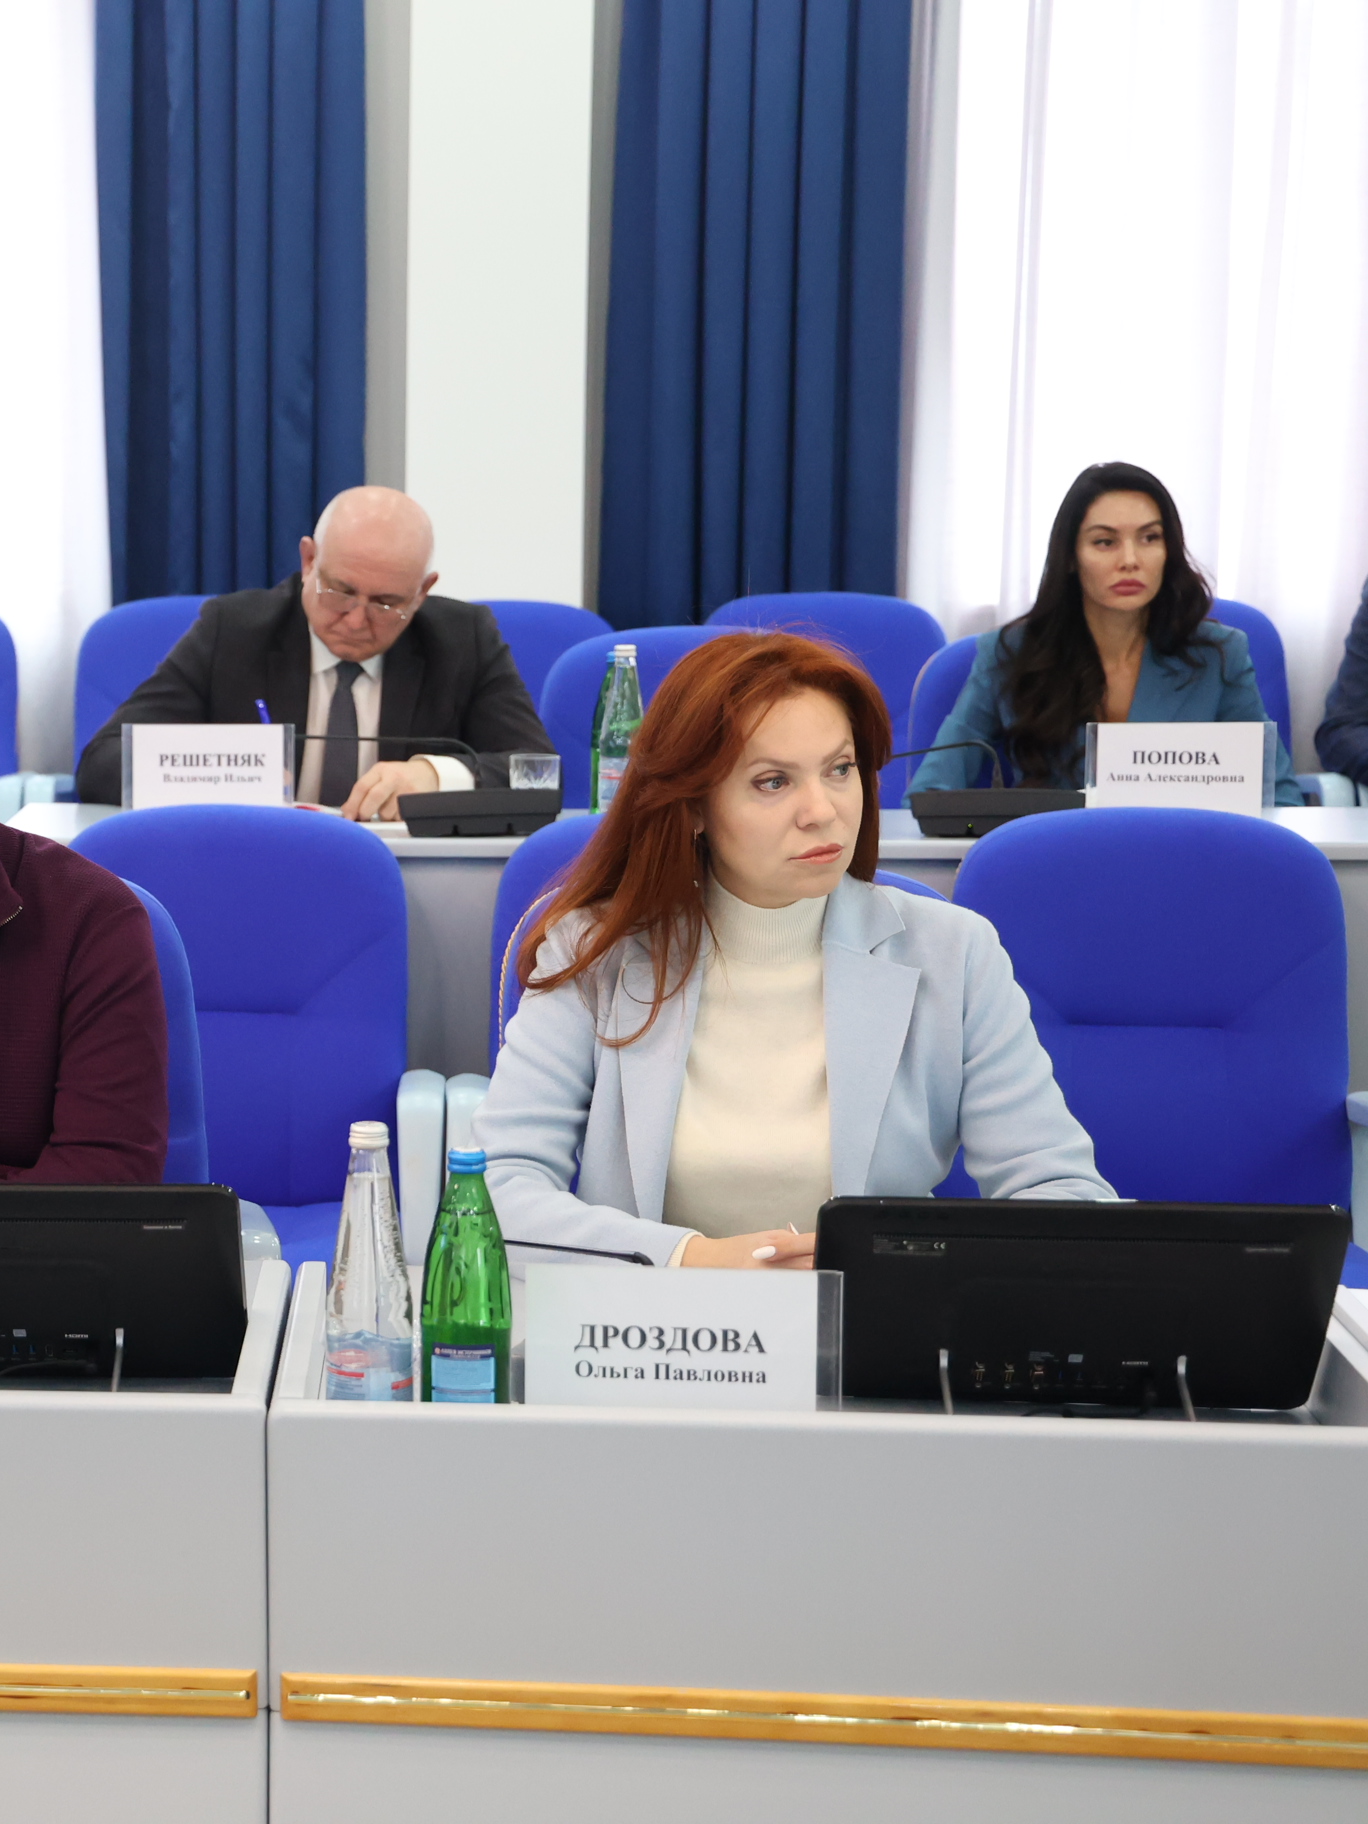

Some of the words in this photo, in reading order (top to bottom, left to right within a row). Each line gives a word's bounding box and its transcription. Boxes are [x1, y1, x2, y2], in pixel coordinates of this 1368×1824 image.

[159, 753, 266, 768] РЕШЕТНЯК
[1132, 750, 1221, 766] ПОПОВА
[163, 773, 222, 785] Владимир
[224, 773, 263, 784] Ильич
[1107, 772, 1140, 782] Анна
[1145, 772, 1245, 785] Александровна
[573, 1324, 767, 1355] ДРОЗДОВА
[574, 1360, 646, 1382] Ольга
[653, 1362, 767, 1384] Павловна
